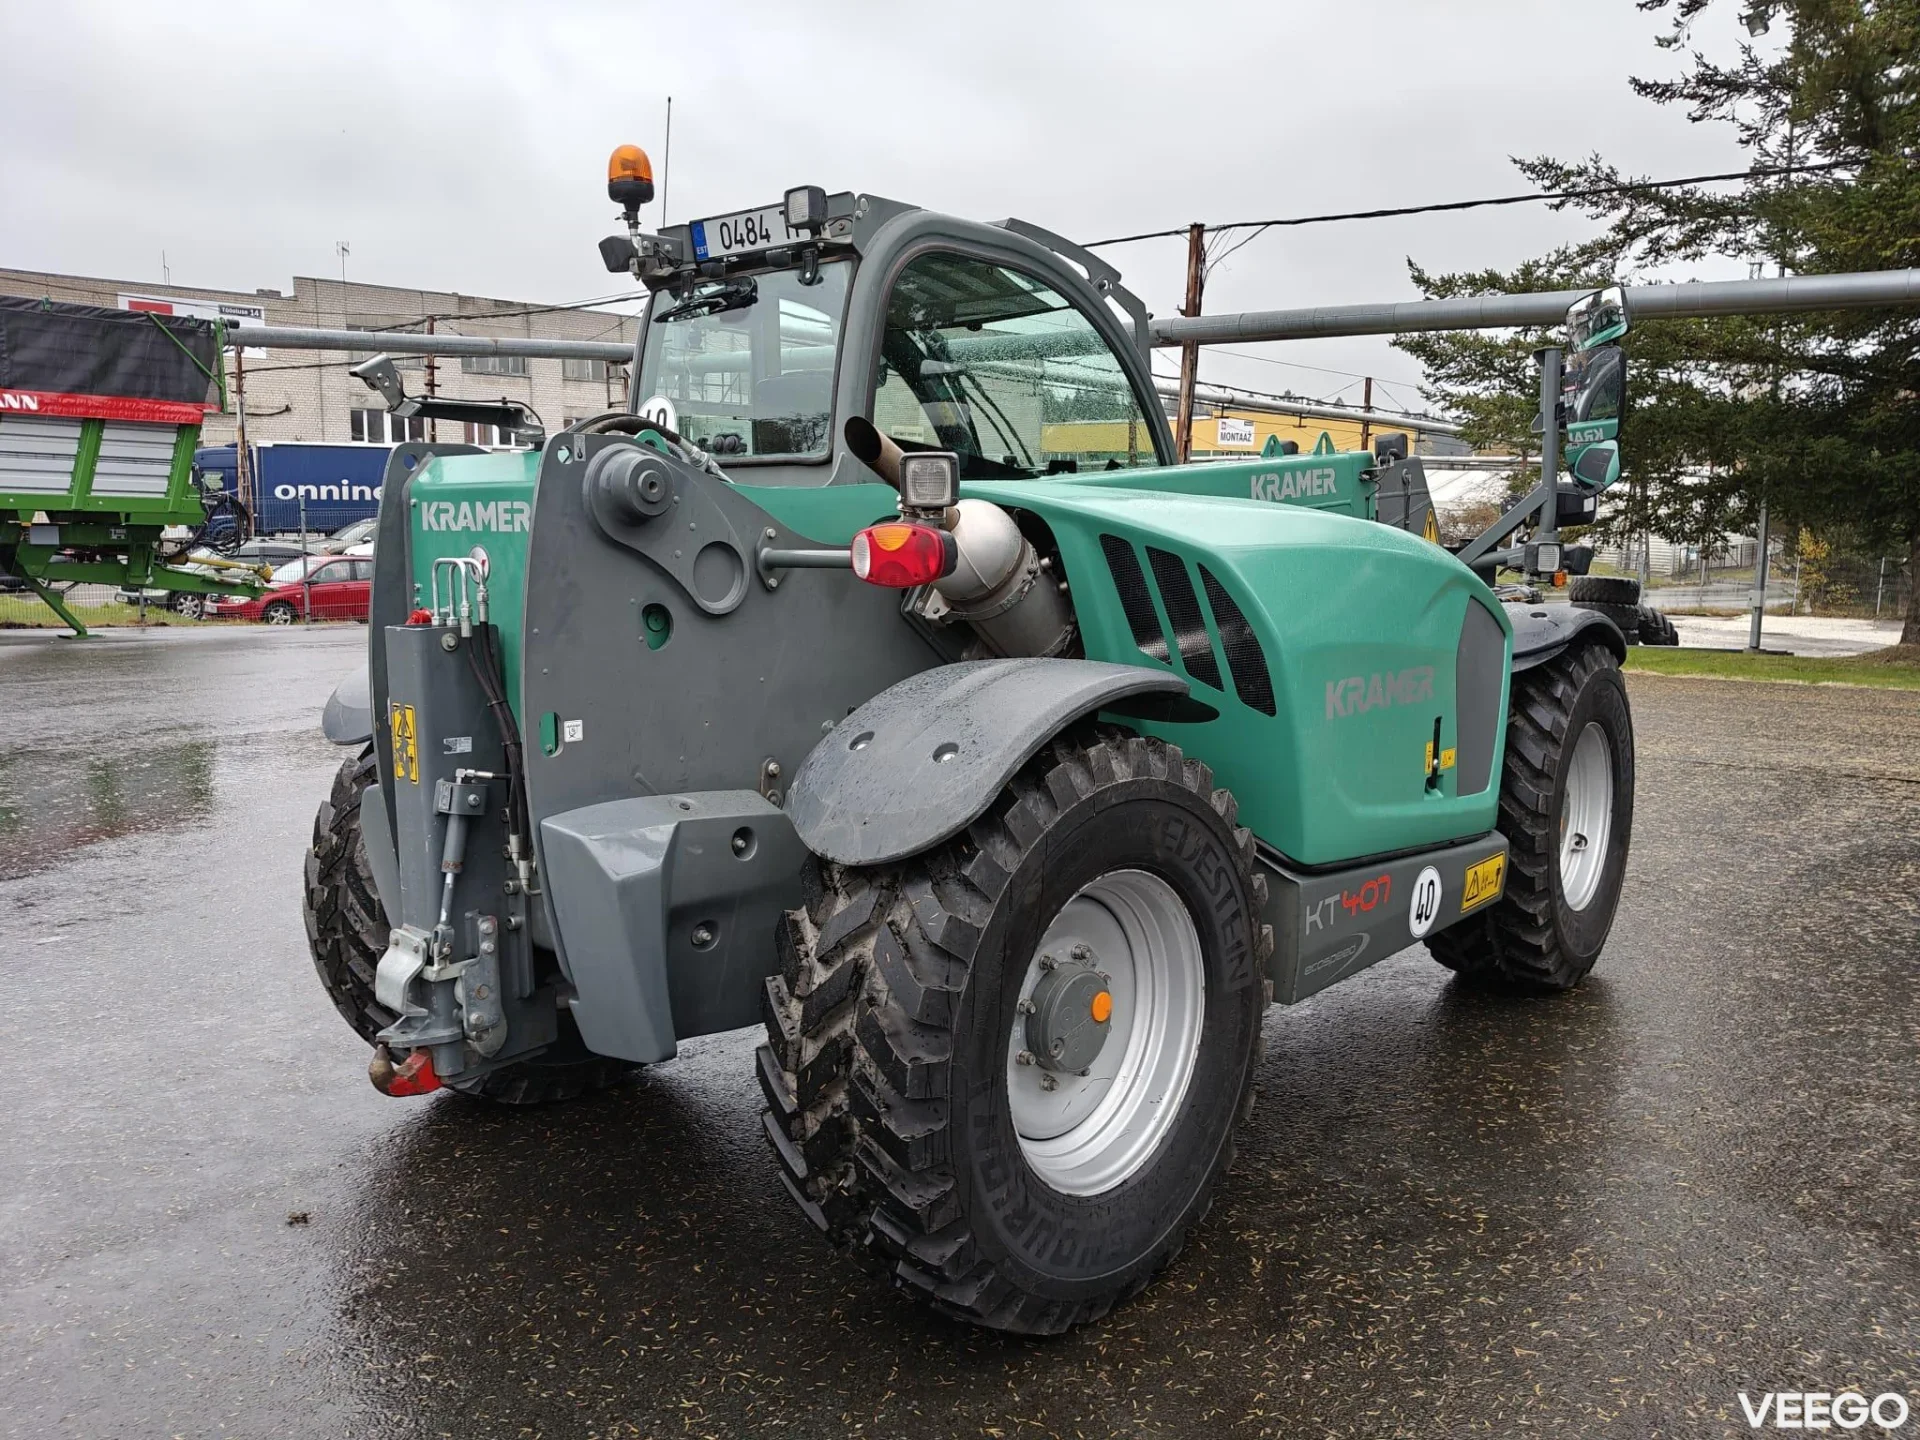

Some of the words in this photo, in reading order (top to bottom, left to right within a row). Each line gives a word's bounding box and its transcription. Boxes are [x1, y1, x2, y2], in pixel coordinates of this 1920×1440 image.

[719, 214, 771, 250] 0484
[696, 245, 708, 255] EST
[0, 393, 39, 410] NN
[1220, 430, 1252, 442] MONTAAŽ
[1251, 468, 1337, 501] KRAMER
[421, 501, 531, 532] KRAMER
[1325, 665, 1435, 720] KRAMER
[1415, 879, 1435, 924] 40
